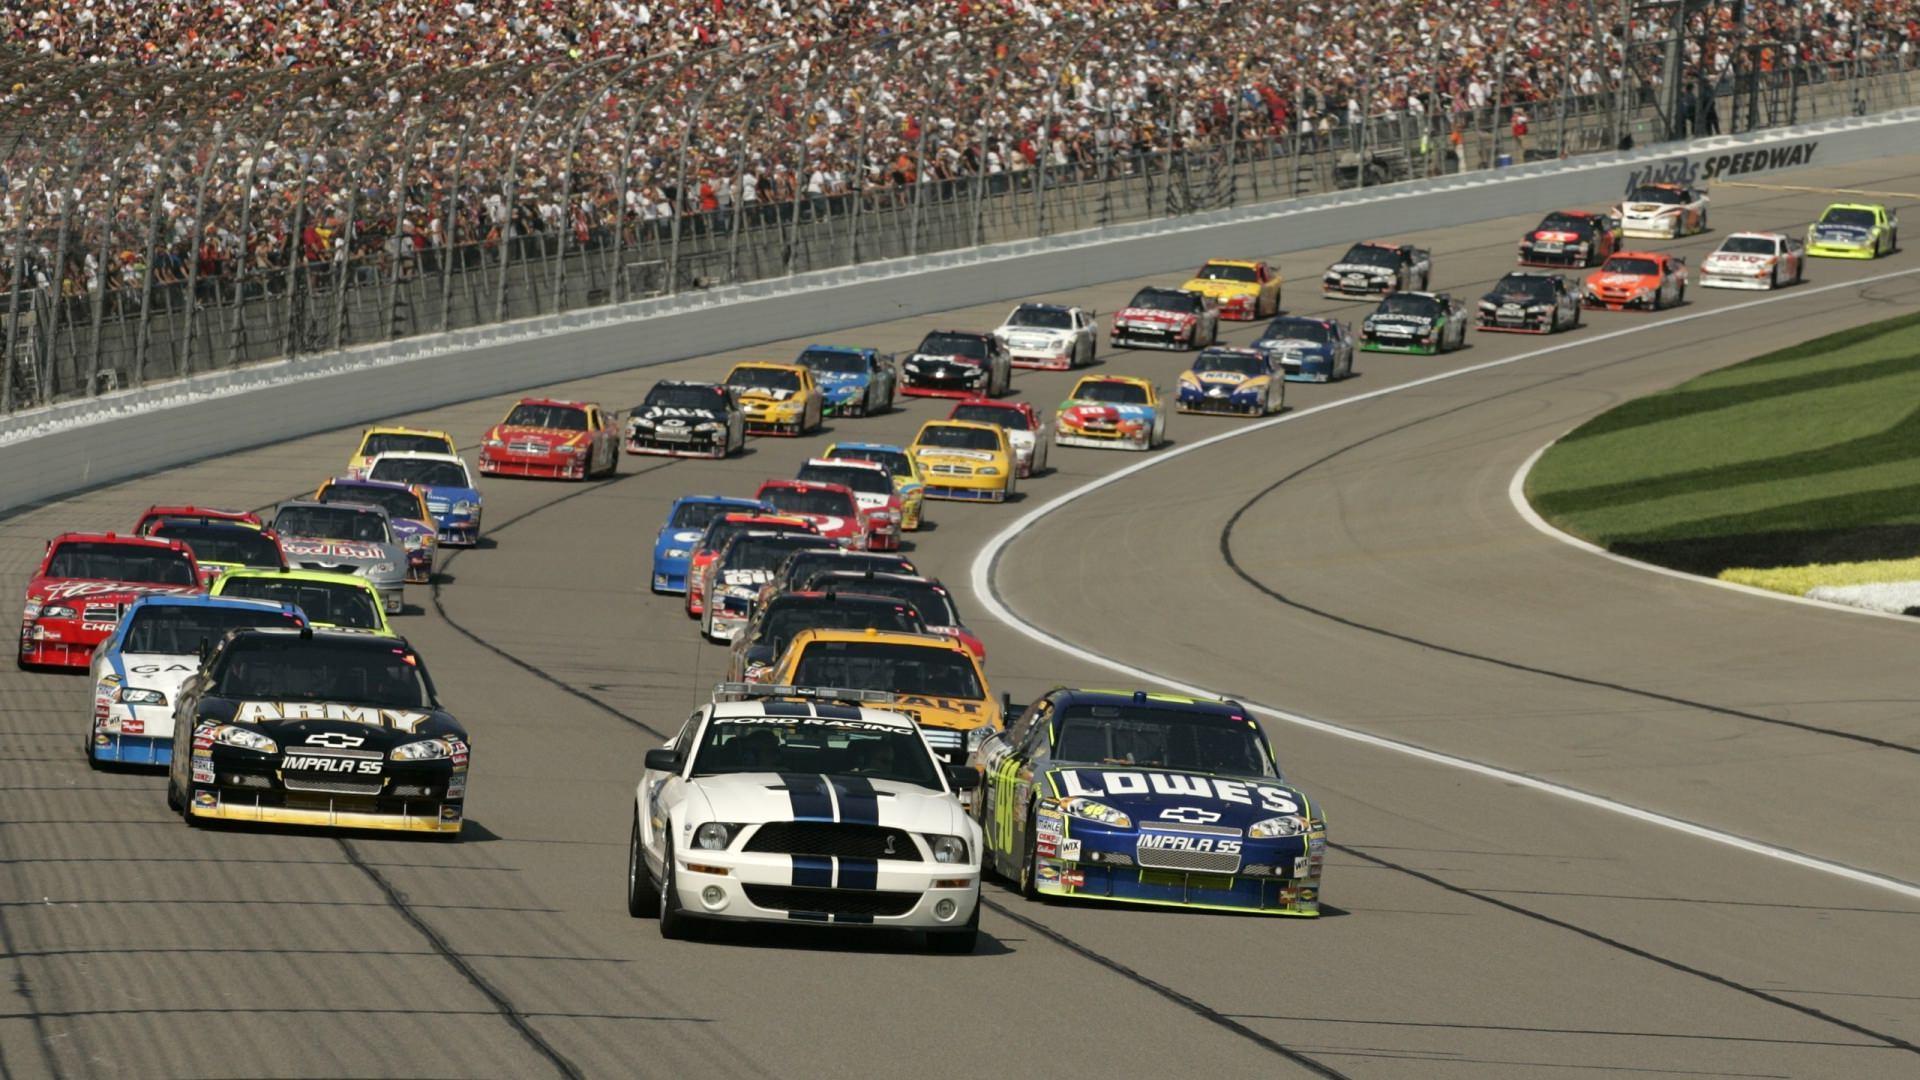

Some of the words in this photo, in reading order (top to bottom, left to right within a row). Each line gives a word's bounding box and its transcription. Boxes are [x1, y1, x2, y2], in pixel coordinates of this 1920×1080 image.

[1625, 157, 1700, 196] KANSAS
[1702, 142, 1818, 180] SPEEDWAY
[644, 406, 715, 419] JACK
[281, 543, 330, 556] Red
[333, 544, 386, 560] Bull
[82, 623, 116, 632] CHA
[233, 701, 431, 734] ARMY
[714, 717, 801, 726] FORD
[803, 718, 914, 735] RACING
[282, 756, 355, 774] IMPALA
[358, 761, 383, 775] SS
[1061, 770, 1298, 813] LOWE'S
[1063, 841, 1079, 851] WIX
[1137, 834, 1213, 851] IMPALA
[1215, 839, 1243, 853] SS
